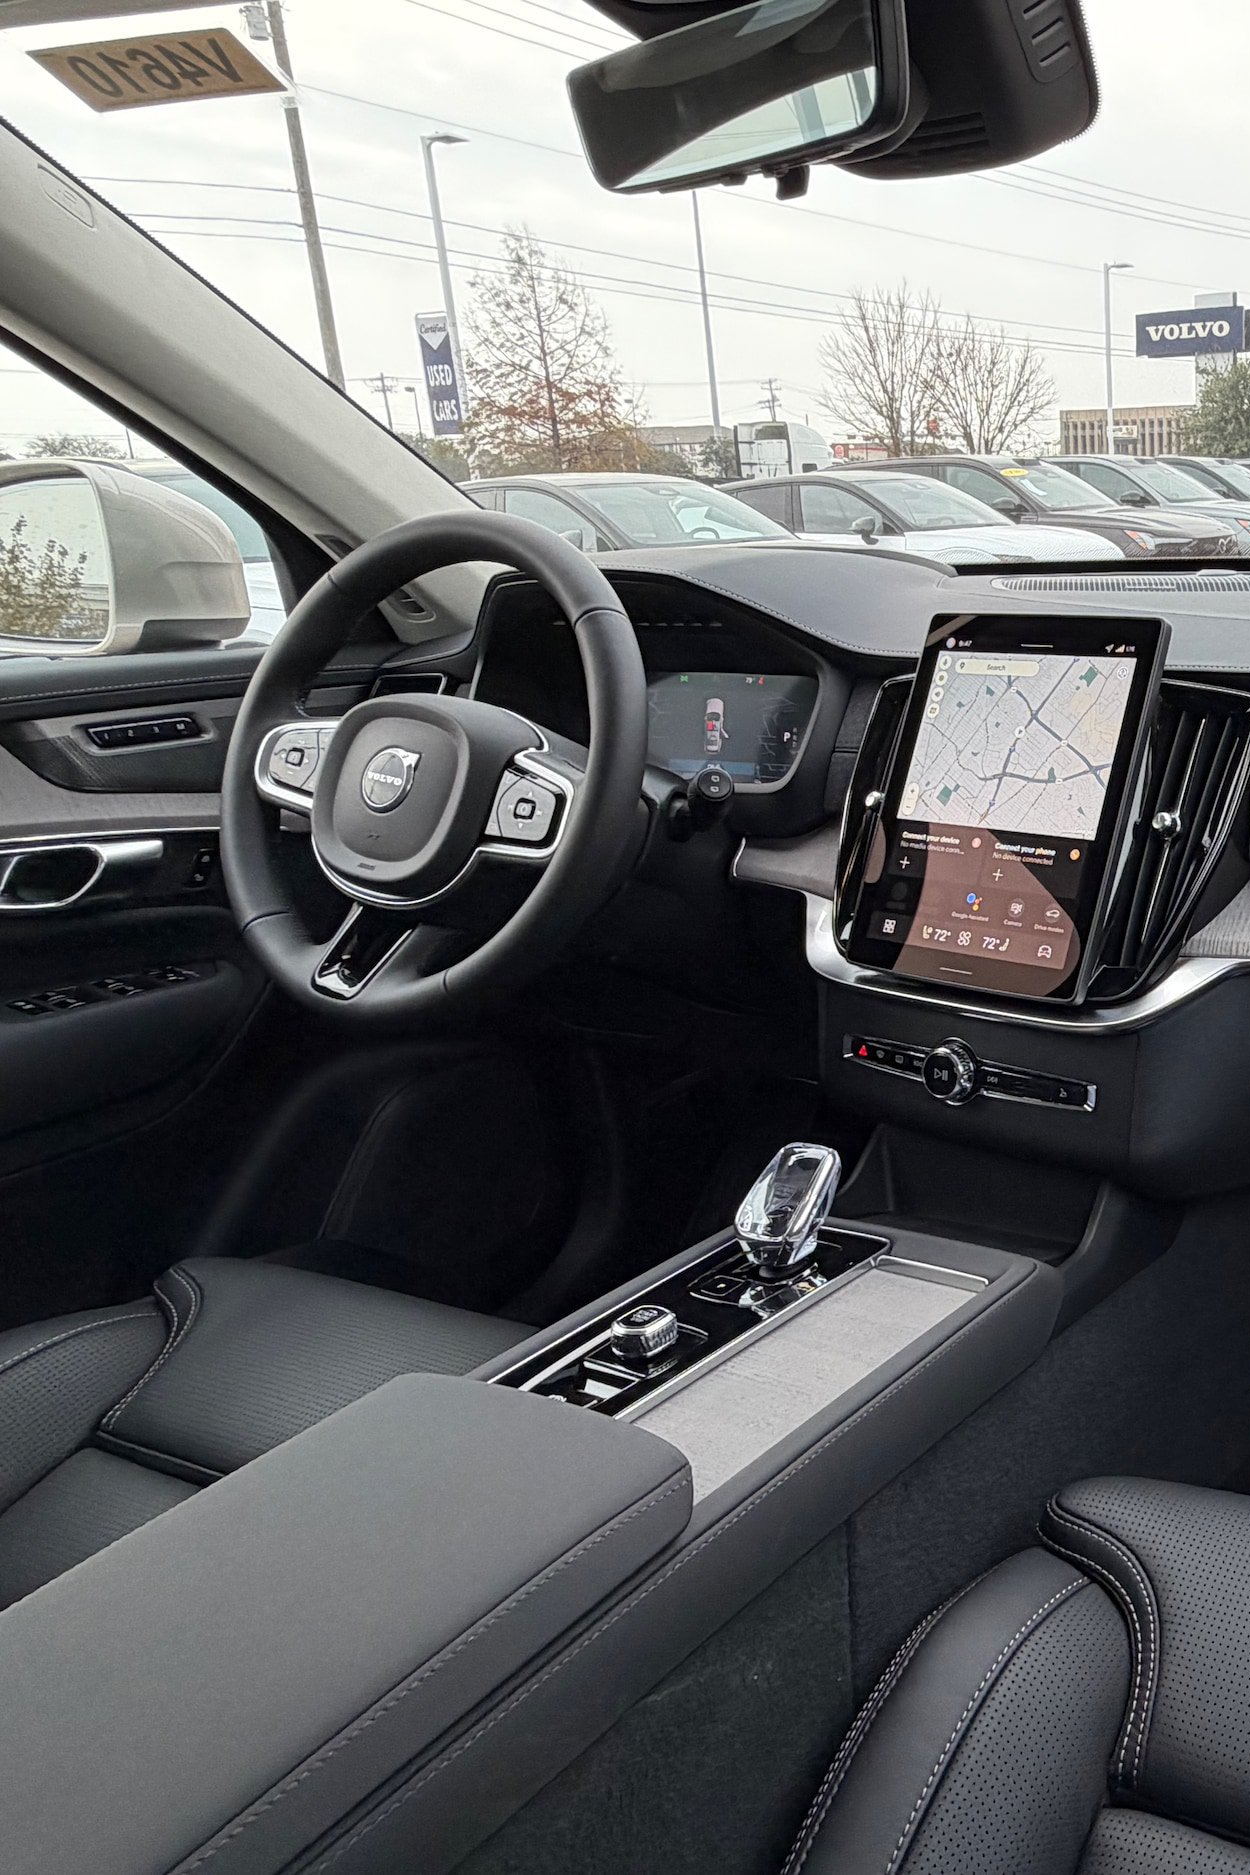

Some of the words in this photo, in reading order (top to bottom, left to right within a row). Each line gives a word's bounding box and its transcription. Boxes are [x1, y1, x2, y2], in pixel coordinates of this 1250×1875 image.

[419, 323, 447, 334] Certified
[1146, 320, 1230, 341] VOLVO
[426, 364, 452, 387] USED
[433, 399, 458, 422] CARS
[783, 731, 791, 743] P
[367, 771, 403, 786] VOLVO
[902, 831, 926, 840] Connect
[940, 836, 960, 845] device
[927, 844, 945, 852] device
[994, 842, 1021, 852] Connect
[1021, 846, 1035, 854] your
[1035, 847, 1056, 856] phone
[992, 851, 1002, 859] No
[1002, 853, 1021, 861] device
[1022, 856, 1054, 866] connected
